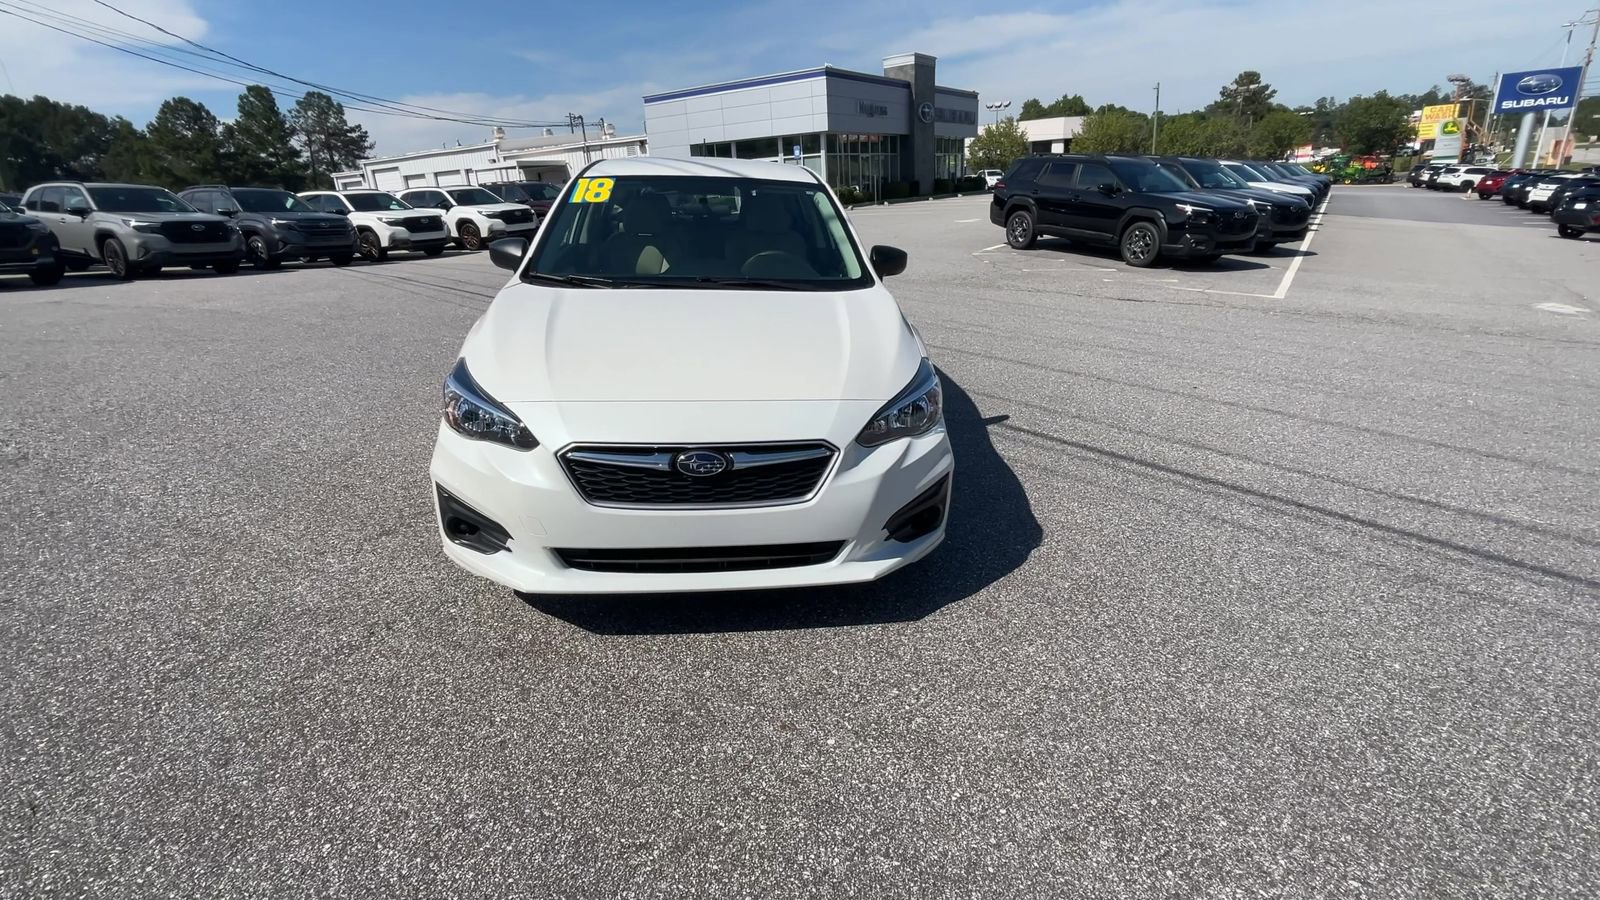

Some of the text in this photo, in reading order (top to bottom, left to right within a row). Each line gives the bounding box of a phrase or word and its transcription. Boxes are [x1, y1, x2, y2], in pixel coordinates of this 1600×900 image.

[1501, 96, 1569, 109] SUBARU
[1425, 111, 1452, 120] WASH
[571, 178, 615, 203] 18
